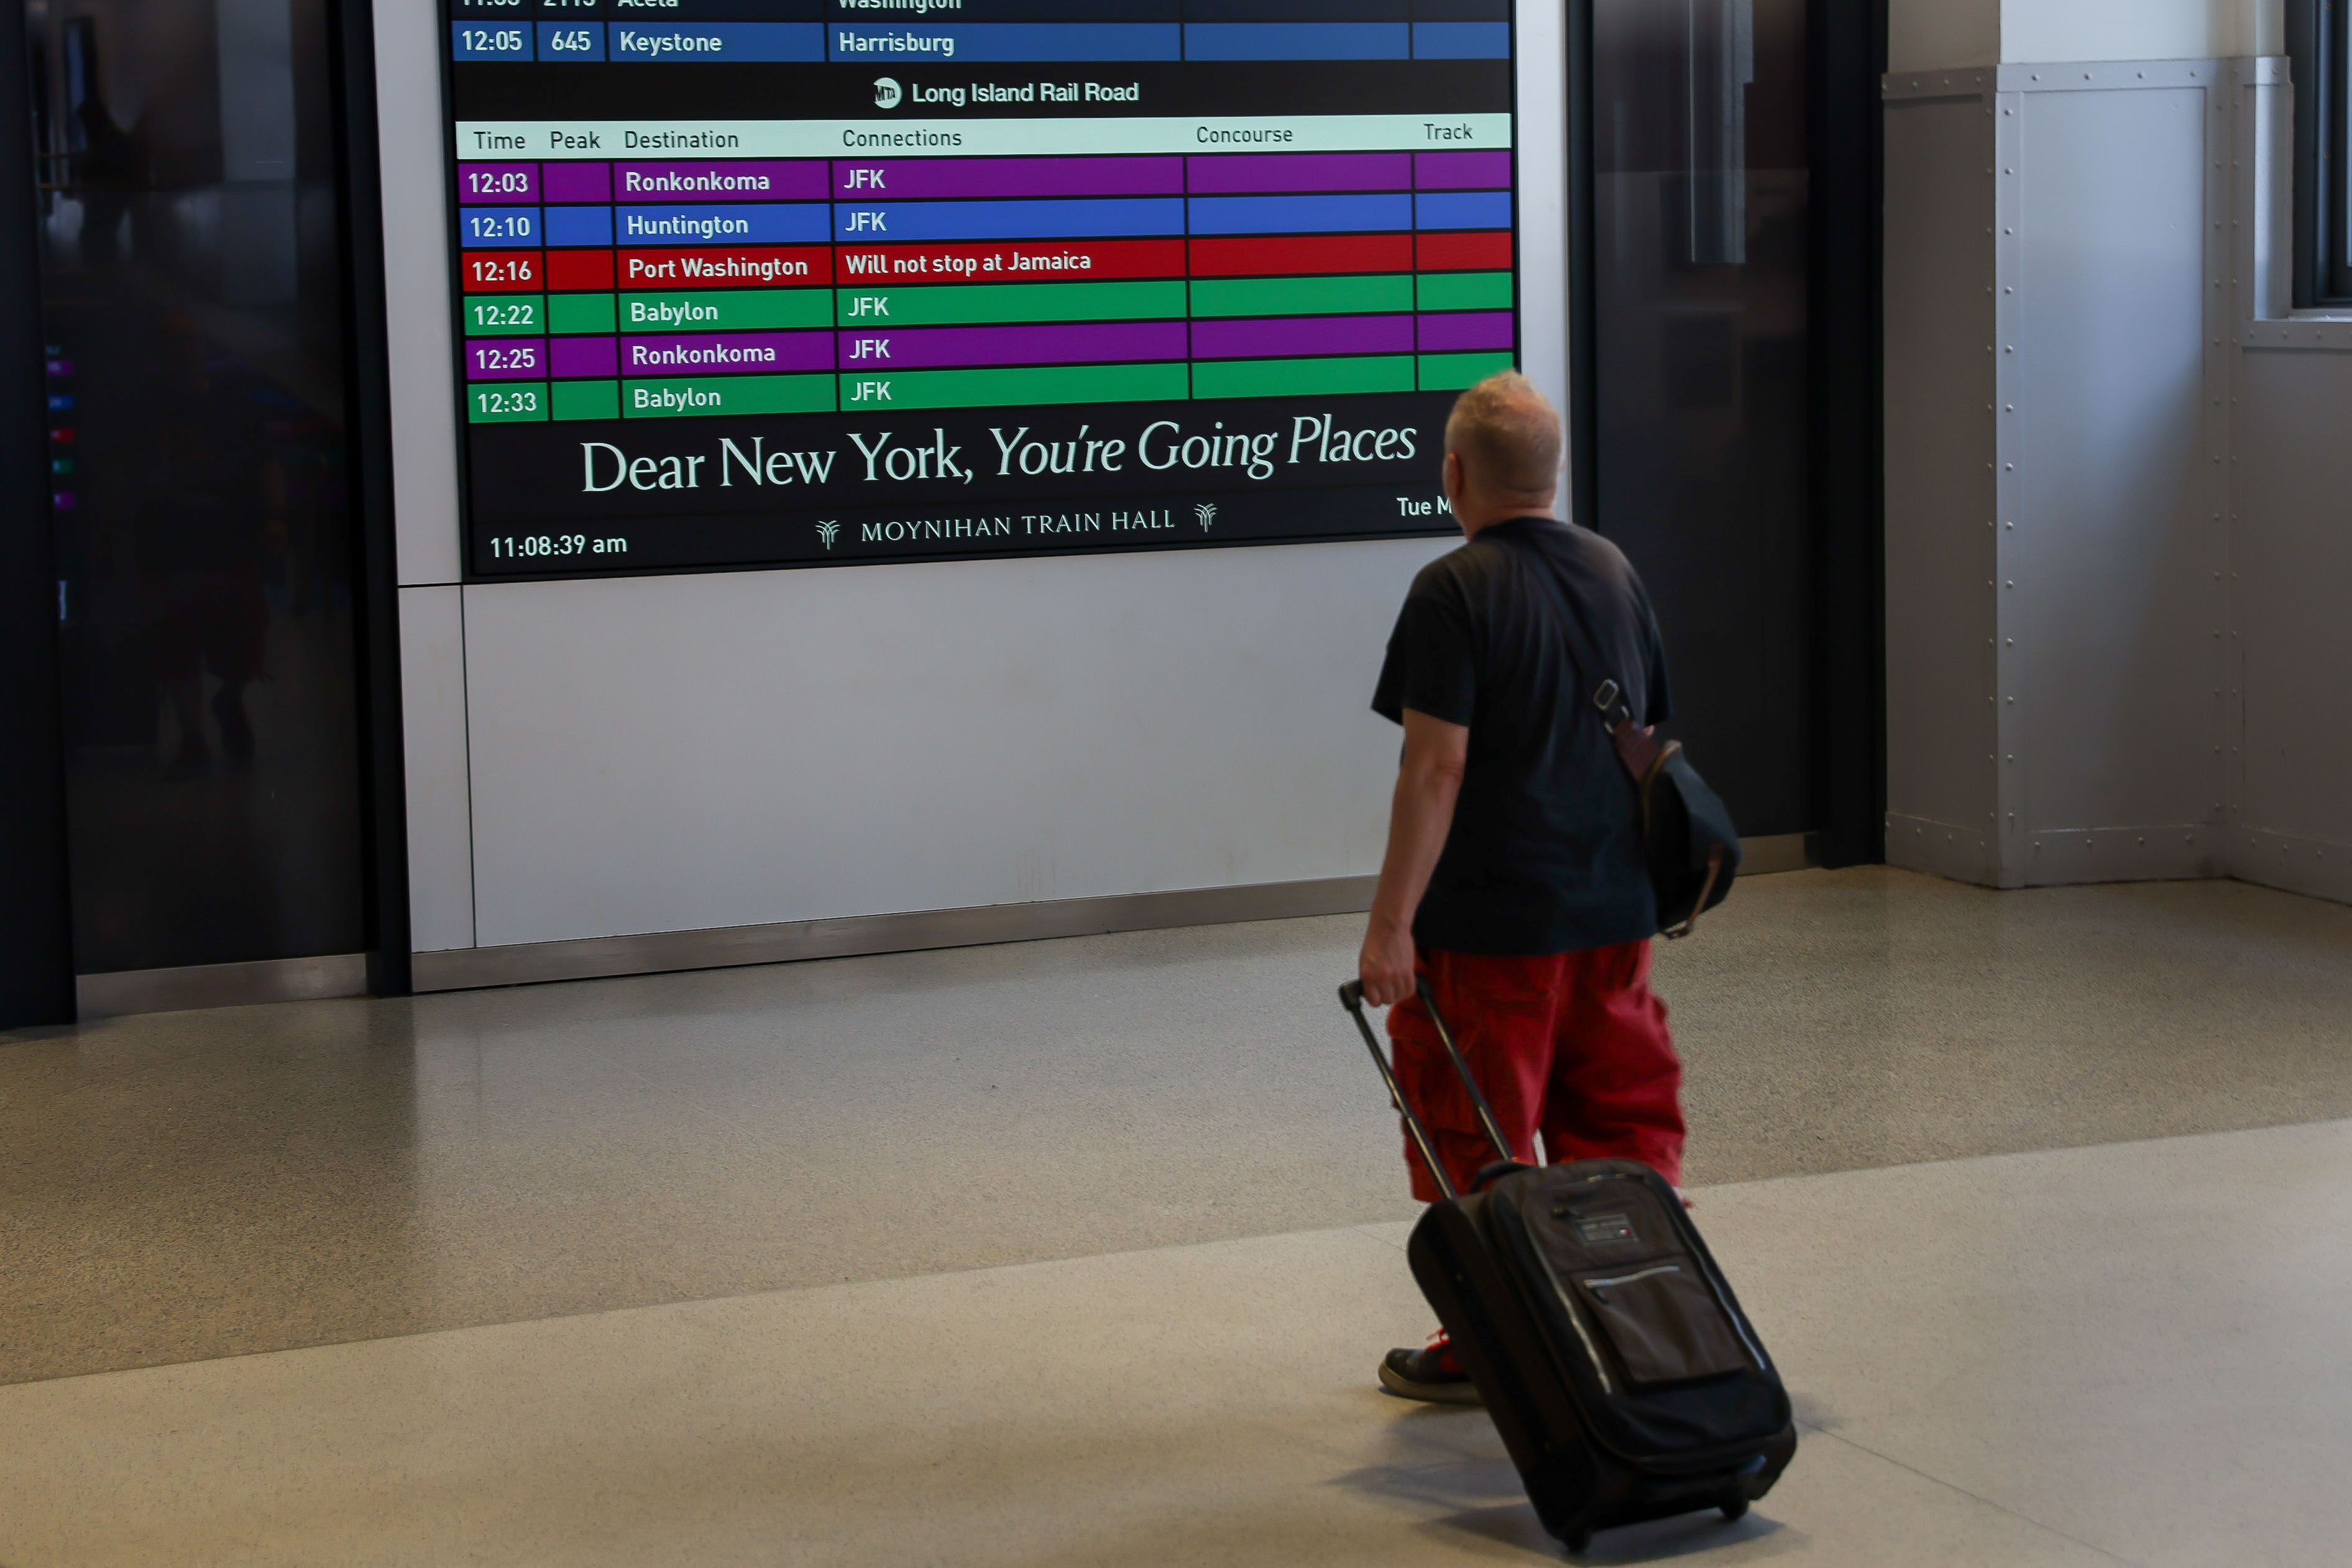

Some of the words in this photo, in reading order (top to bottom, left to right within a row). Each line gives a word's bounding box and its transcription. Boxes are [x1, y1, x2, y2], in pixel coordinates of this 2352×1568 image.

[462, 31, 522, 50] 12:05
[552, 31, 590, 50] 645
[620, 32, 722, 56] Keystone
[840, 32, 954, 57] Harrisburg
[912, 84, 965, 106] Long
[972, 83, 1034, 101] Island
[1040, 83, 1078, 101] Rail
[1085, 83, 1139, 101] Road
[474, 132, 525, 149] Time
[551, 131, 600, 149] Peak
[625, 131, 738, 148] Destination
[843, 129, 962, 147] Connections
[1197, 127, 1292, 142] Concourse
[1423, 124, 1472, 139] Track
[469, 173, 528, 192] 12:03
[627, 172, 769, 191] Ronkonkoma
[844, 170, 885, 188] JFK
[471, 218, 530, 237] 12:10
[628, 215, 748, 239] Huntington
[845, 213, 886, 231] JFK
[472, 261, 531, 281] 12:16
[630, 259, 676, 278] Port
[681, 257, 807, 281] Washington
[845, 255, 888, 273] Will
[894, 256, 927, 273] not
[933, 255, 977, 277] stop
[983, 254, 1002, 270] at
[1008, 251, 1090, 270] Jamaica
[474, 305, 533, 325] 12:22
[632, 301, 718, 326] Babylon
[848, 297, 889, 316] JFK
[633, 344, 774, 365] Ronkonkoma
[849, 339, 890, 359] JFK
[476, 349, 535, 369] 12:25
[635, 388, 720, 411] Babylon
[851, 382, 891, 401] JFK
[478, 393, 536, 412] 12:33
[580, 443, 705, 492] Dear
[719, 437, 837, 486] New
[847, 428, 973, 484] York,
[988, 425, 1125, 475] You're
[1139, 421, 1278, 479] Going
[1287, 414, 1417, 463] Places
[1397, 497, 1431, 516] Tue
[862, 517, 1010, 541] MOYNIHAN
[1021, 513, 1100, 533] TRAIN
[1112, 510, 1174, 530] HALL
[491, 534, 585, 557] 11:08:39
[593, 538, 627, 552] am
